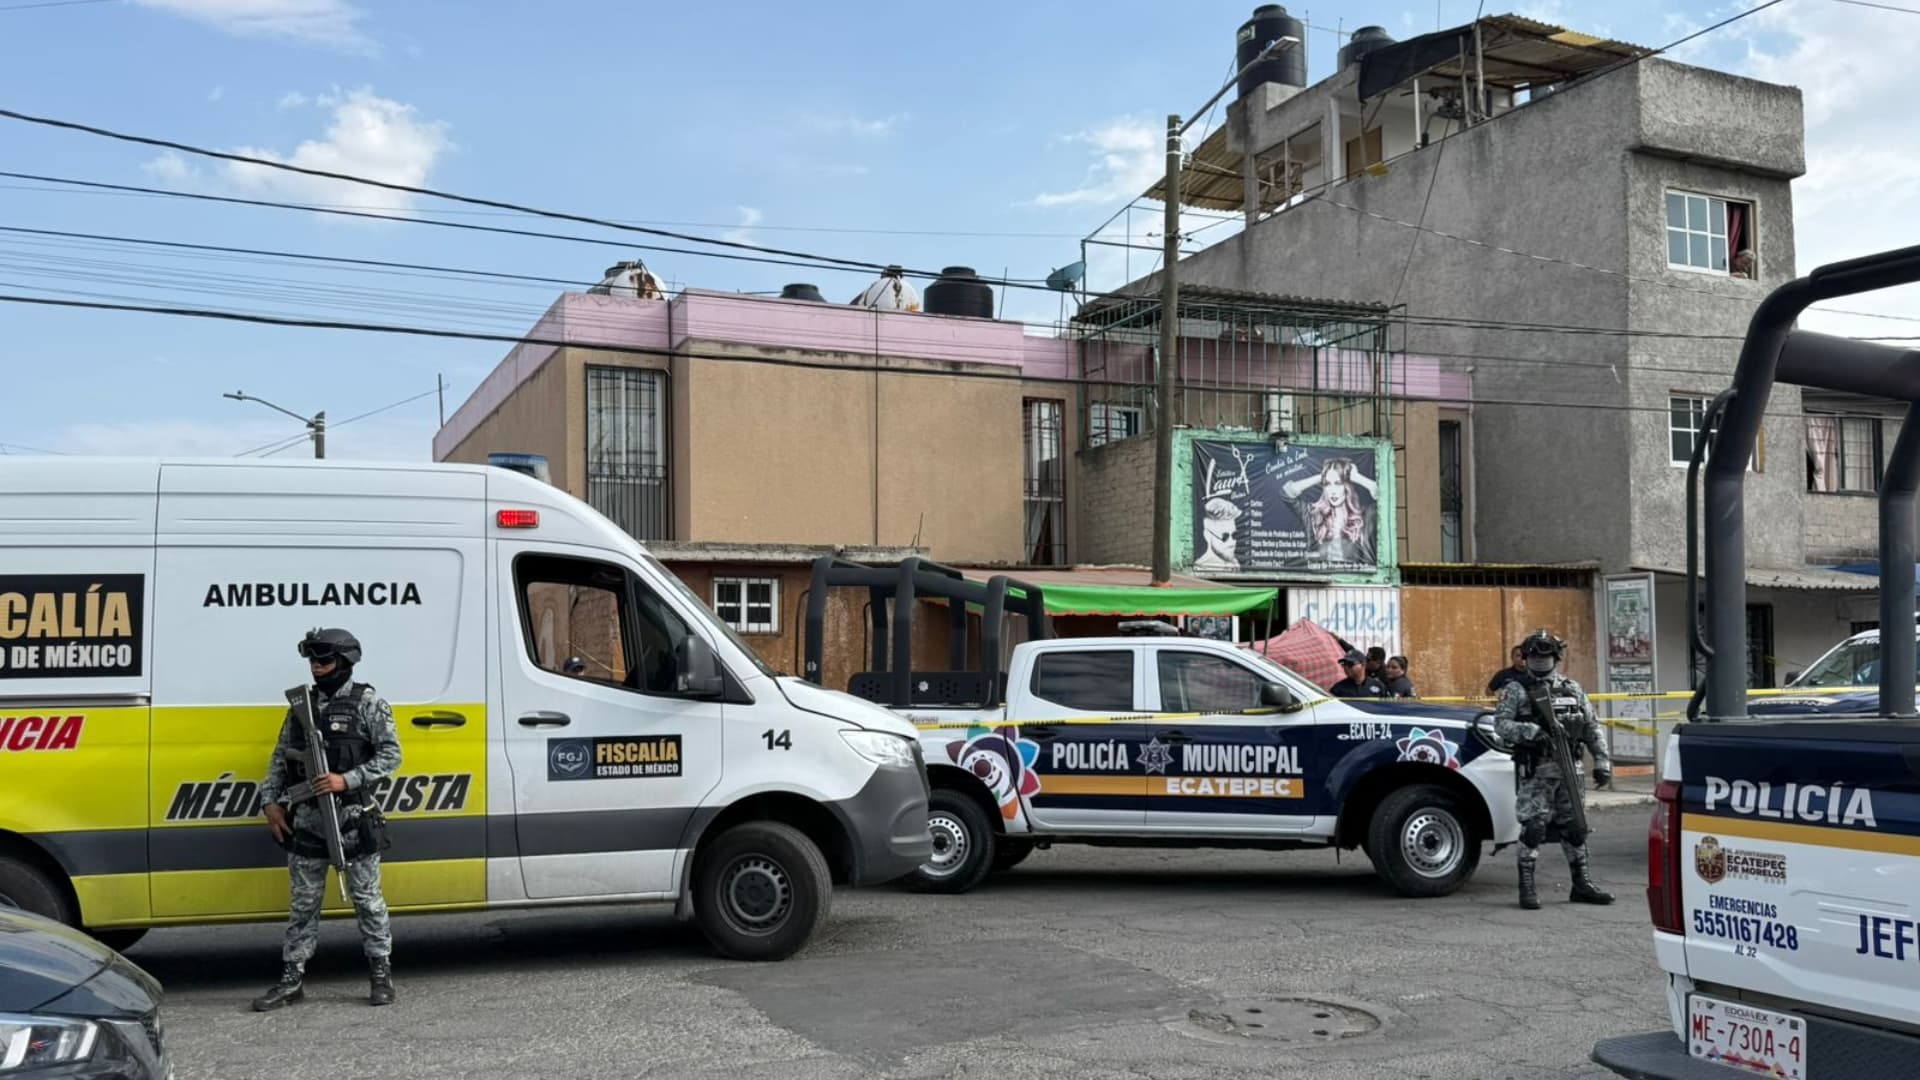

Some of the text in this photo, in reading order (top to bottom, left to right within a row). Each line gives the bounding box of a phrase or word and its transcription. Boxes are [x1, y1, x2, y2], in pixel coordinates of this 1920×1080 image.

[203, 582, 422, 607] AMBULANCIA
[0, 583, 132, 639] CALÍA
[11, 645, 39, 669] DE
[45, 641, 132, 668] MÉXICO
[596, 738, 678, 763] FISCALÍA
[761, 729, 792, 750] 14
[558, 752, 583, 762] FGJ
[597, 761, 679, 776] ESTADO DE MÉXICO
[1052, 738, 1303, 774] POLICÍA MUNICIPAL
[1166, 778, 1291, 796] ECATEPEC
[1705, 776, 1877, 828] POLICÍA
[1727, 855, 1786, 870] ECATEPEC
[1727, 865, 1739, 873] DE
[1741, 867, 1786, 879] MORELOS
[1709, 894, 1777, 918] EMERGENCIAS
[1693, 909, 1799, 950] 5551167428
[1856, 914, 1920, 962] JEF
[1735, 944, 1744, 956] AL
[1692, 1013, 1800, 1063] ME-730A-4
